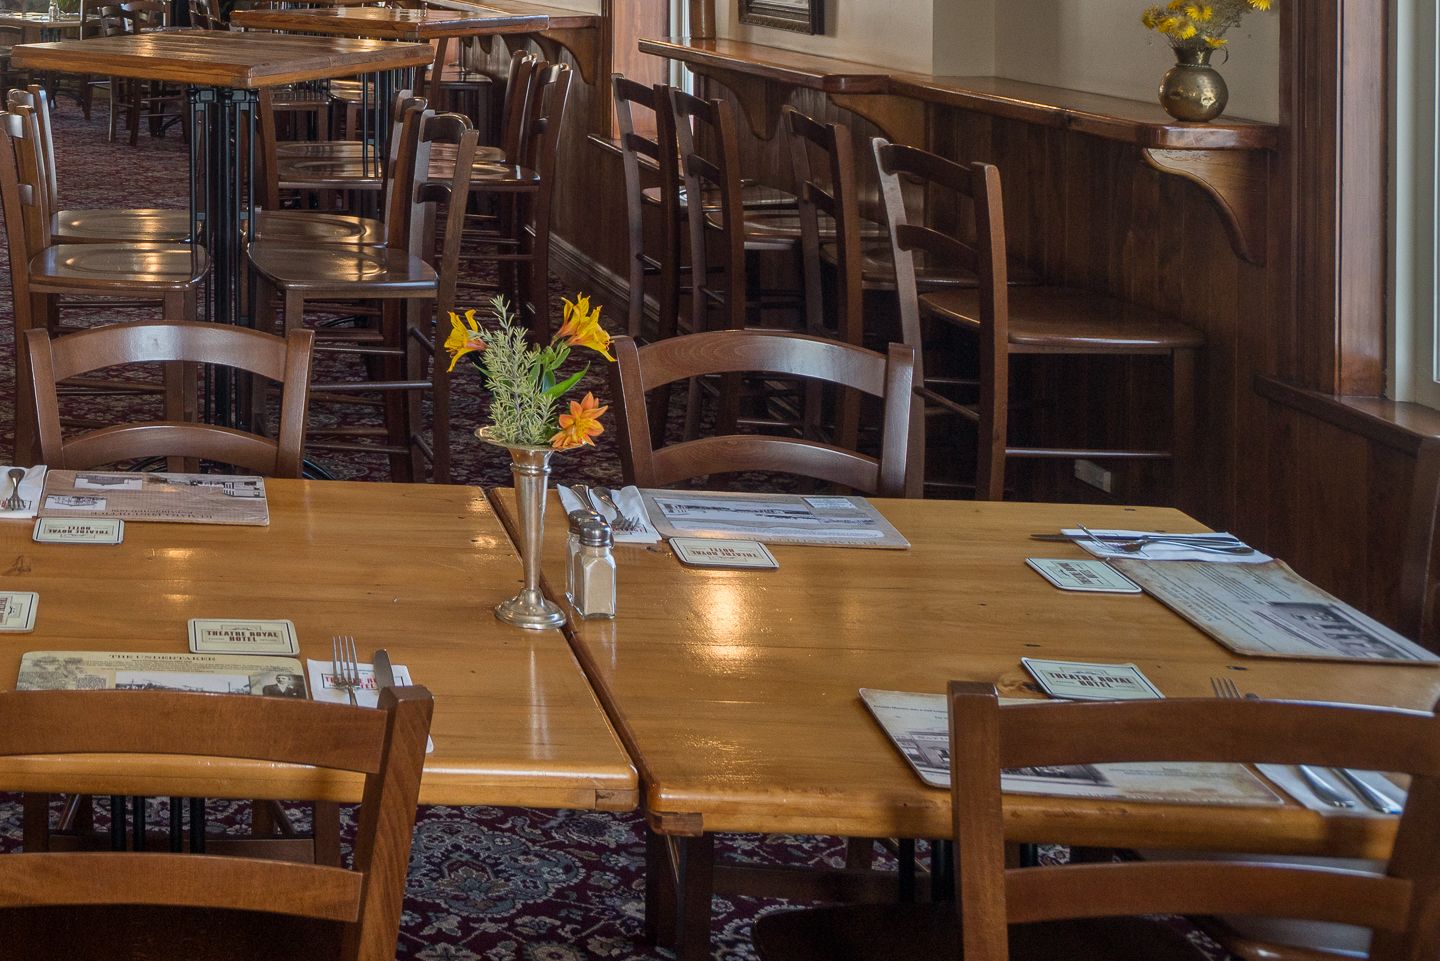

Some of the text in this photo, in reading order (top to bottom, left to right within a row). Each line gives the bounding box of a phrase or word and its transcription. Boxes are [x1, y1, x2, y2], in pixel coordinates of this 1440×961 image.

[1048, 672, 1134, 684] THEATRE ROYAL
[1077, 680, 1113, 688] HOTEL
